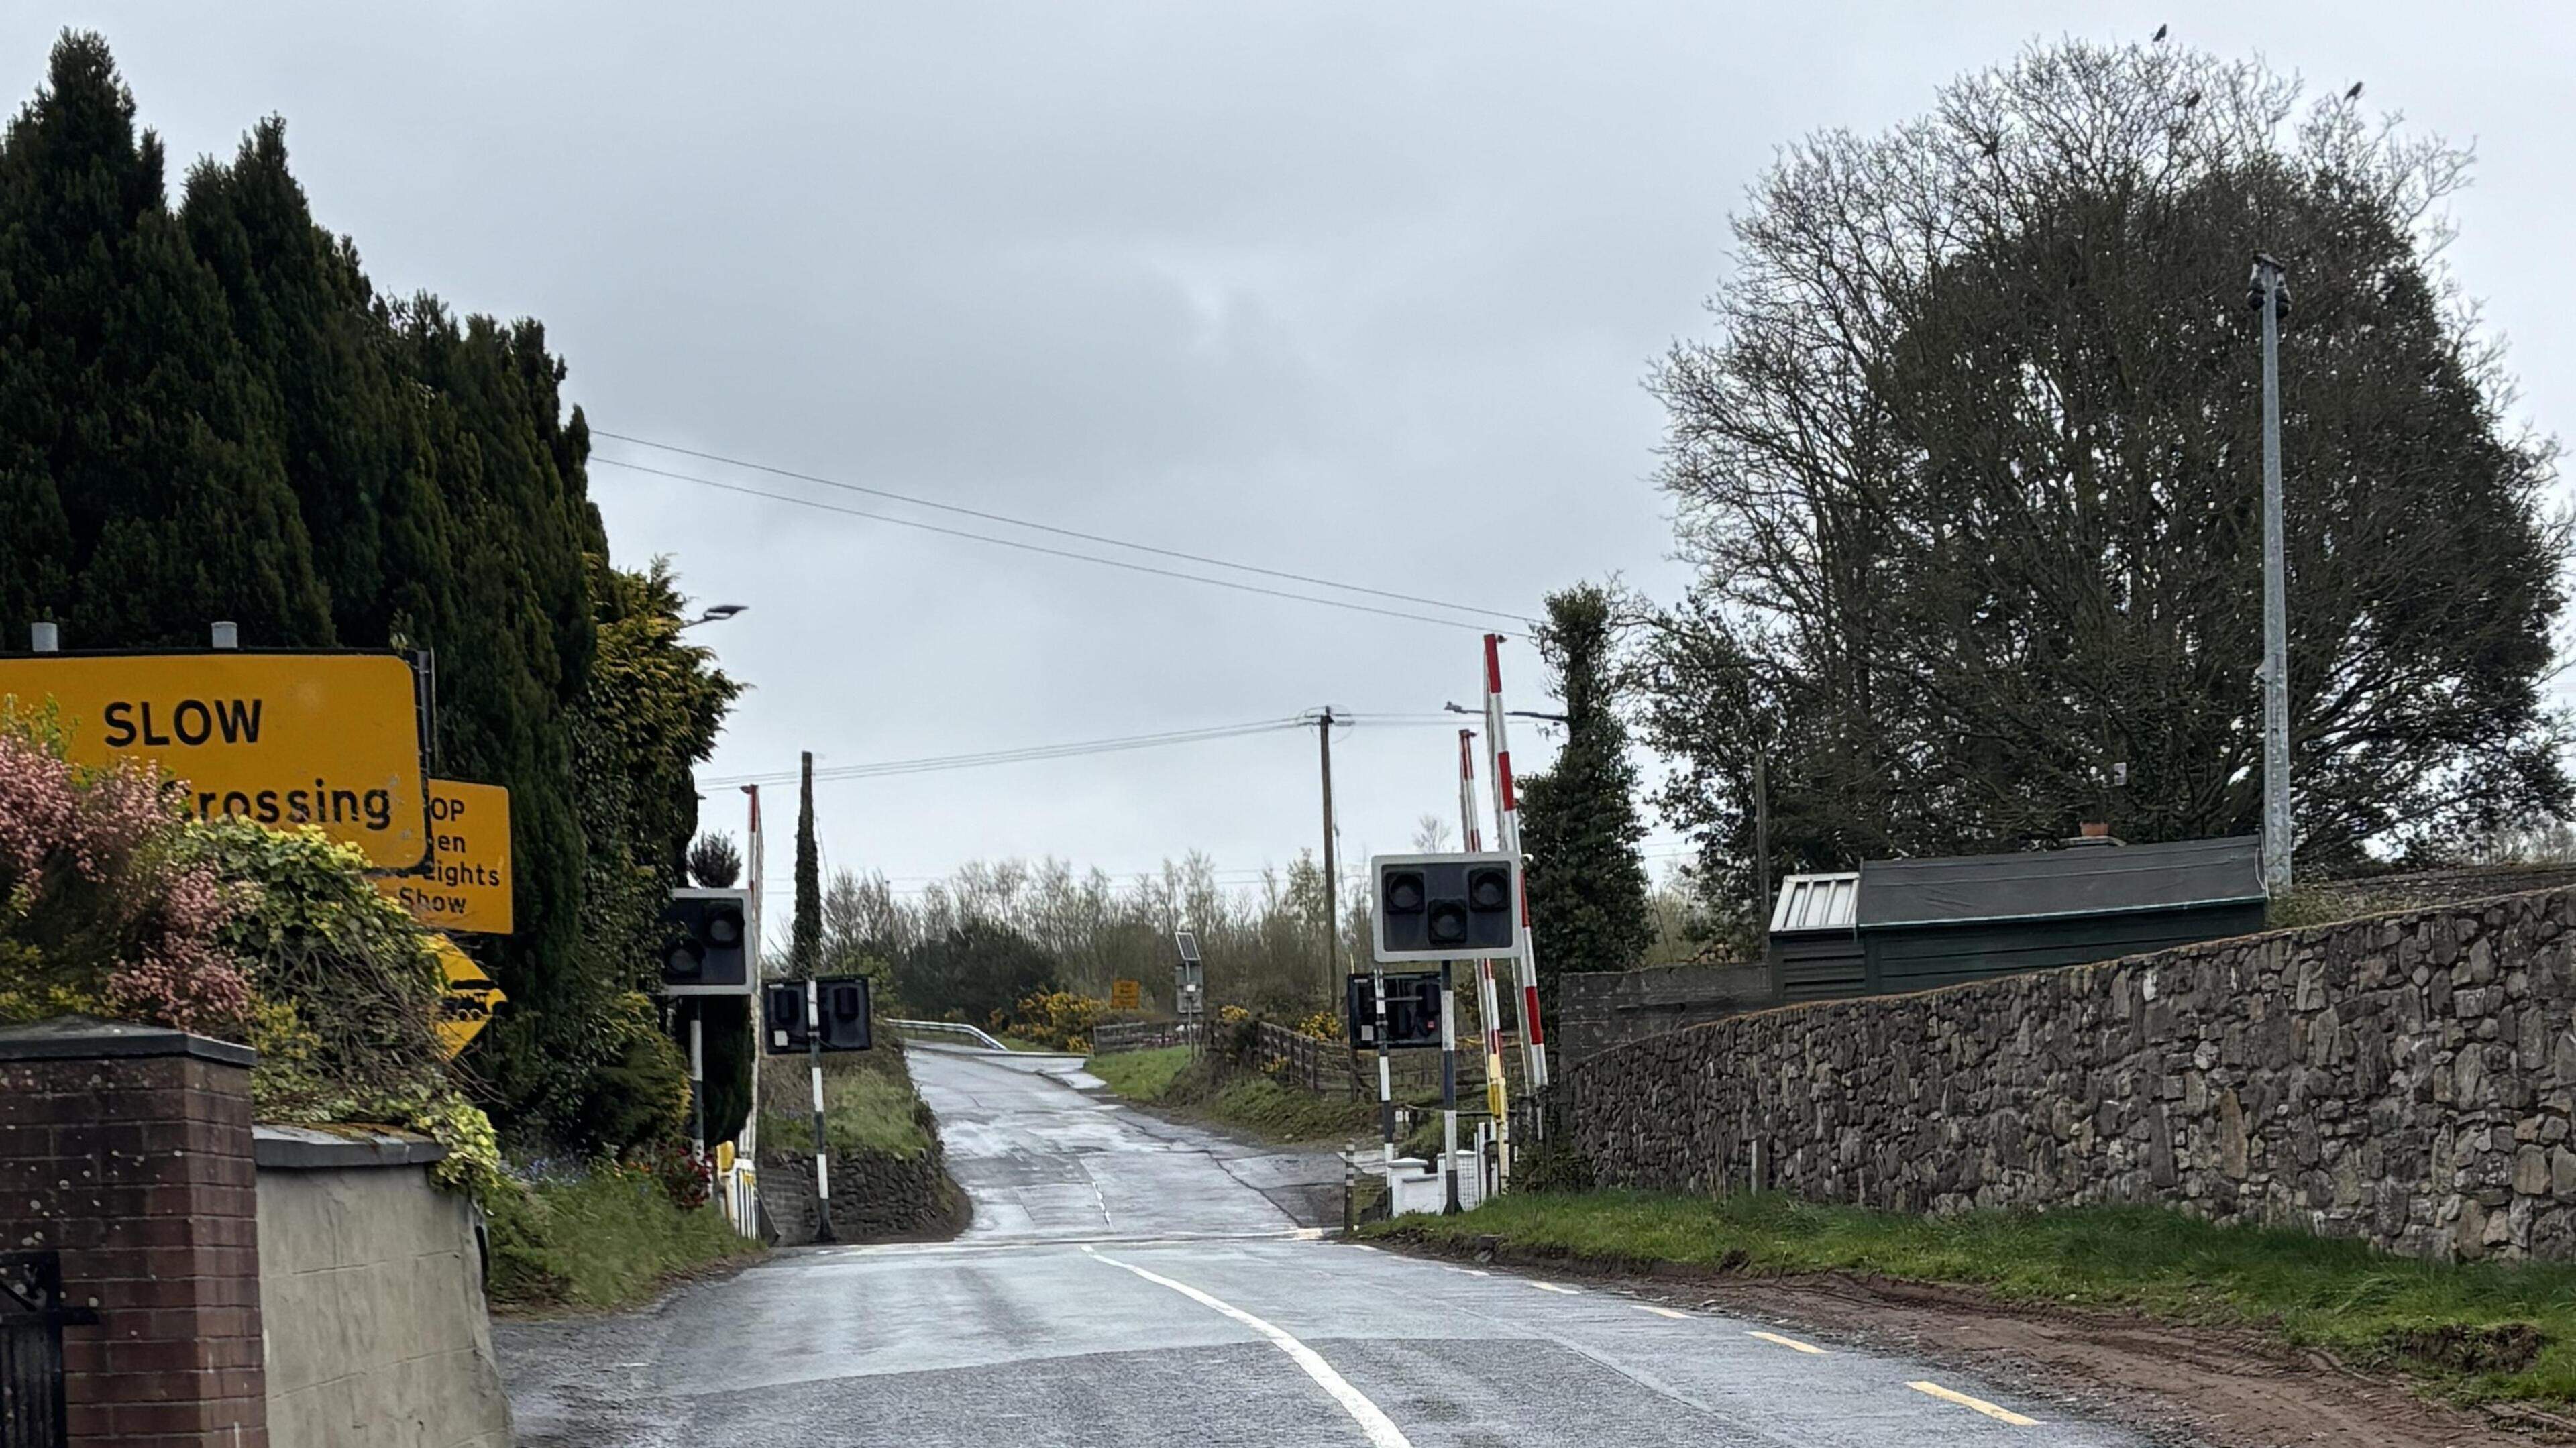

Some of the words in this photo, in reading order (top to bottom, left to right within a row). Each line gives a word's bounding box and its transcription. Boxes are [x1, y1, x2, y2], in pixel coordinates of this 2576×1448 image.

[105, 699, 262, 747] SLOW
[431, 797, 465, 821] OP
[437, 834, 466, 854] en
[399, 887, 466, 915] Show
